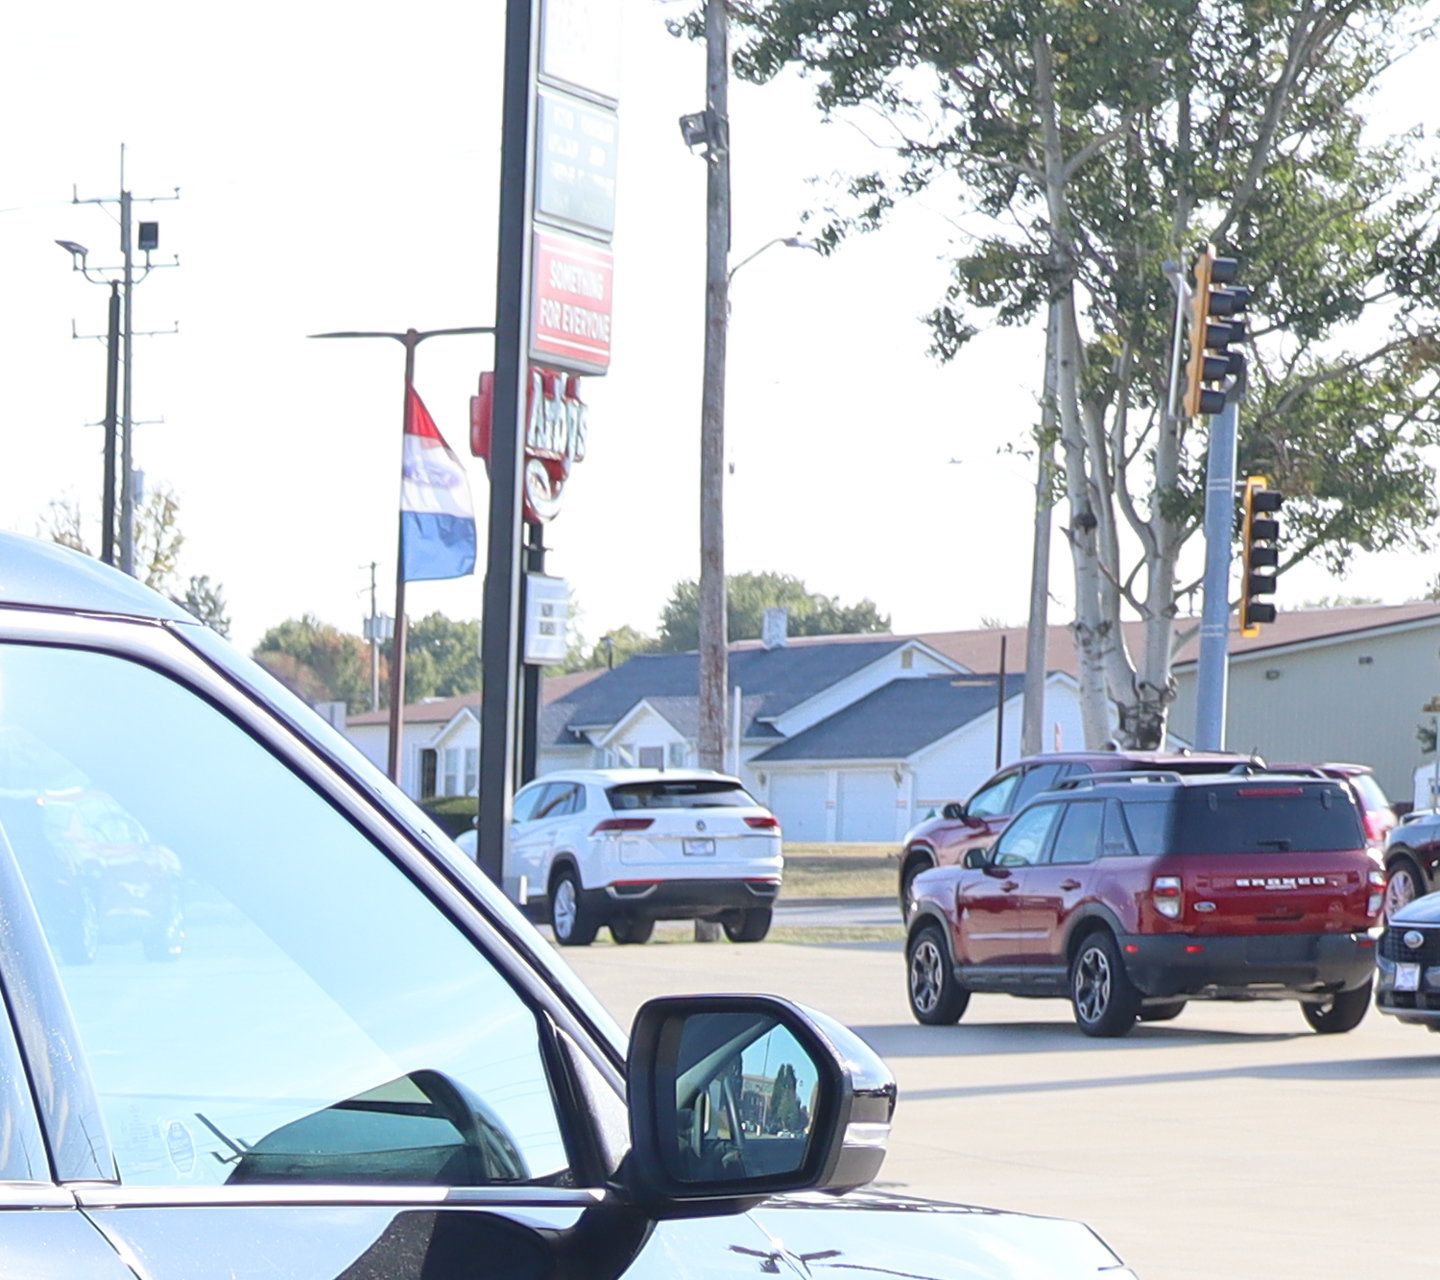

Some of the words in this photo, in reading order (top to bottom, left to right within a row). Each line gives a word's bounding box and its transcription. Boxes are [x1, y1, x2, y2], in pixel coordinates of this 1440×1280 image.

[548, 259, 605, 303] SOMETHING
[539, 298, 561, 331] FOR
[562, 302, 611, 344] EVERYONE
